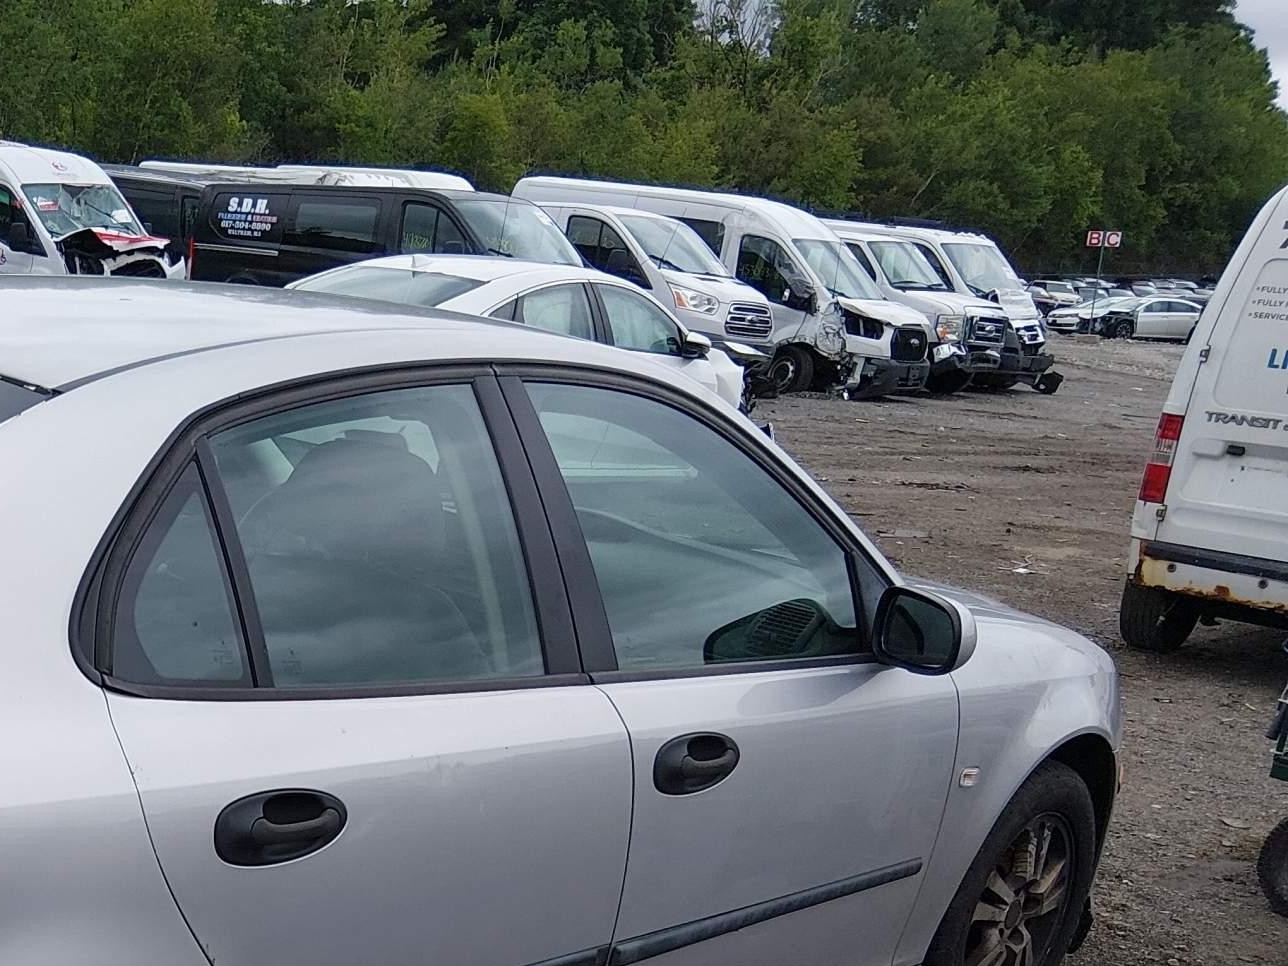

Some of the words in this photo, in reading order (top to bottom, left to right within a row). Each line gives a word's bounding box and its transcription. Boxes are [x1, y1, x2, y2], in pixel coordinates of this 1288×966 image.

[227, 197, 270, 215] S.D.H.
[1089, 231, 1102, 246] B
[1107, 232, 1120, 246] C
[1260, 285, 1288, 294] FULLY
[1256, 298, 1285, 307] FULLY
[1204, 410, 1283, 430] TRANSIT
